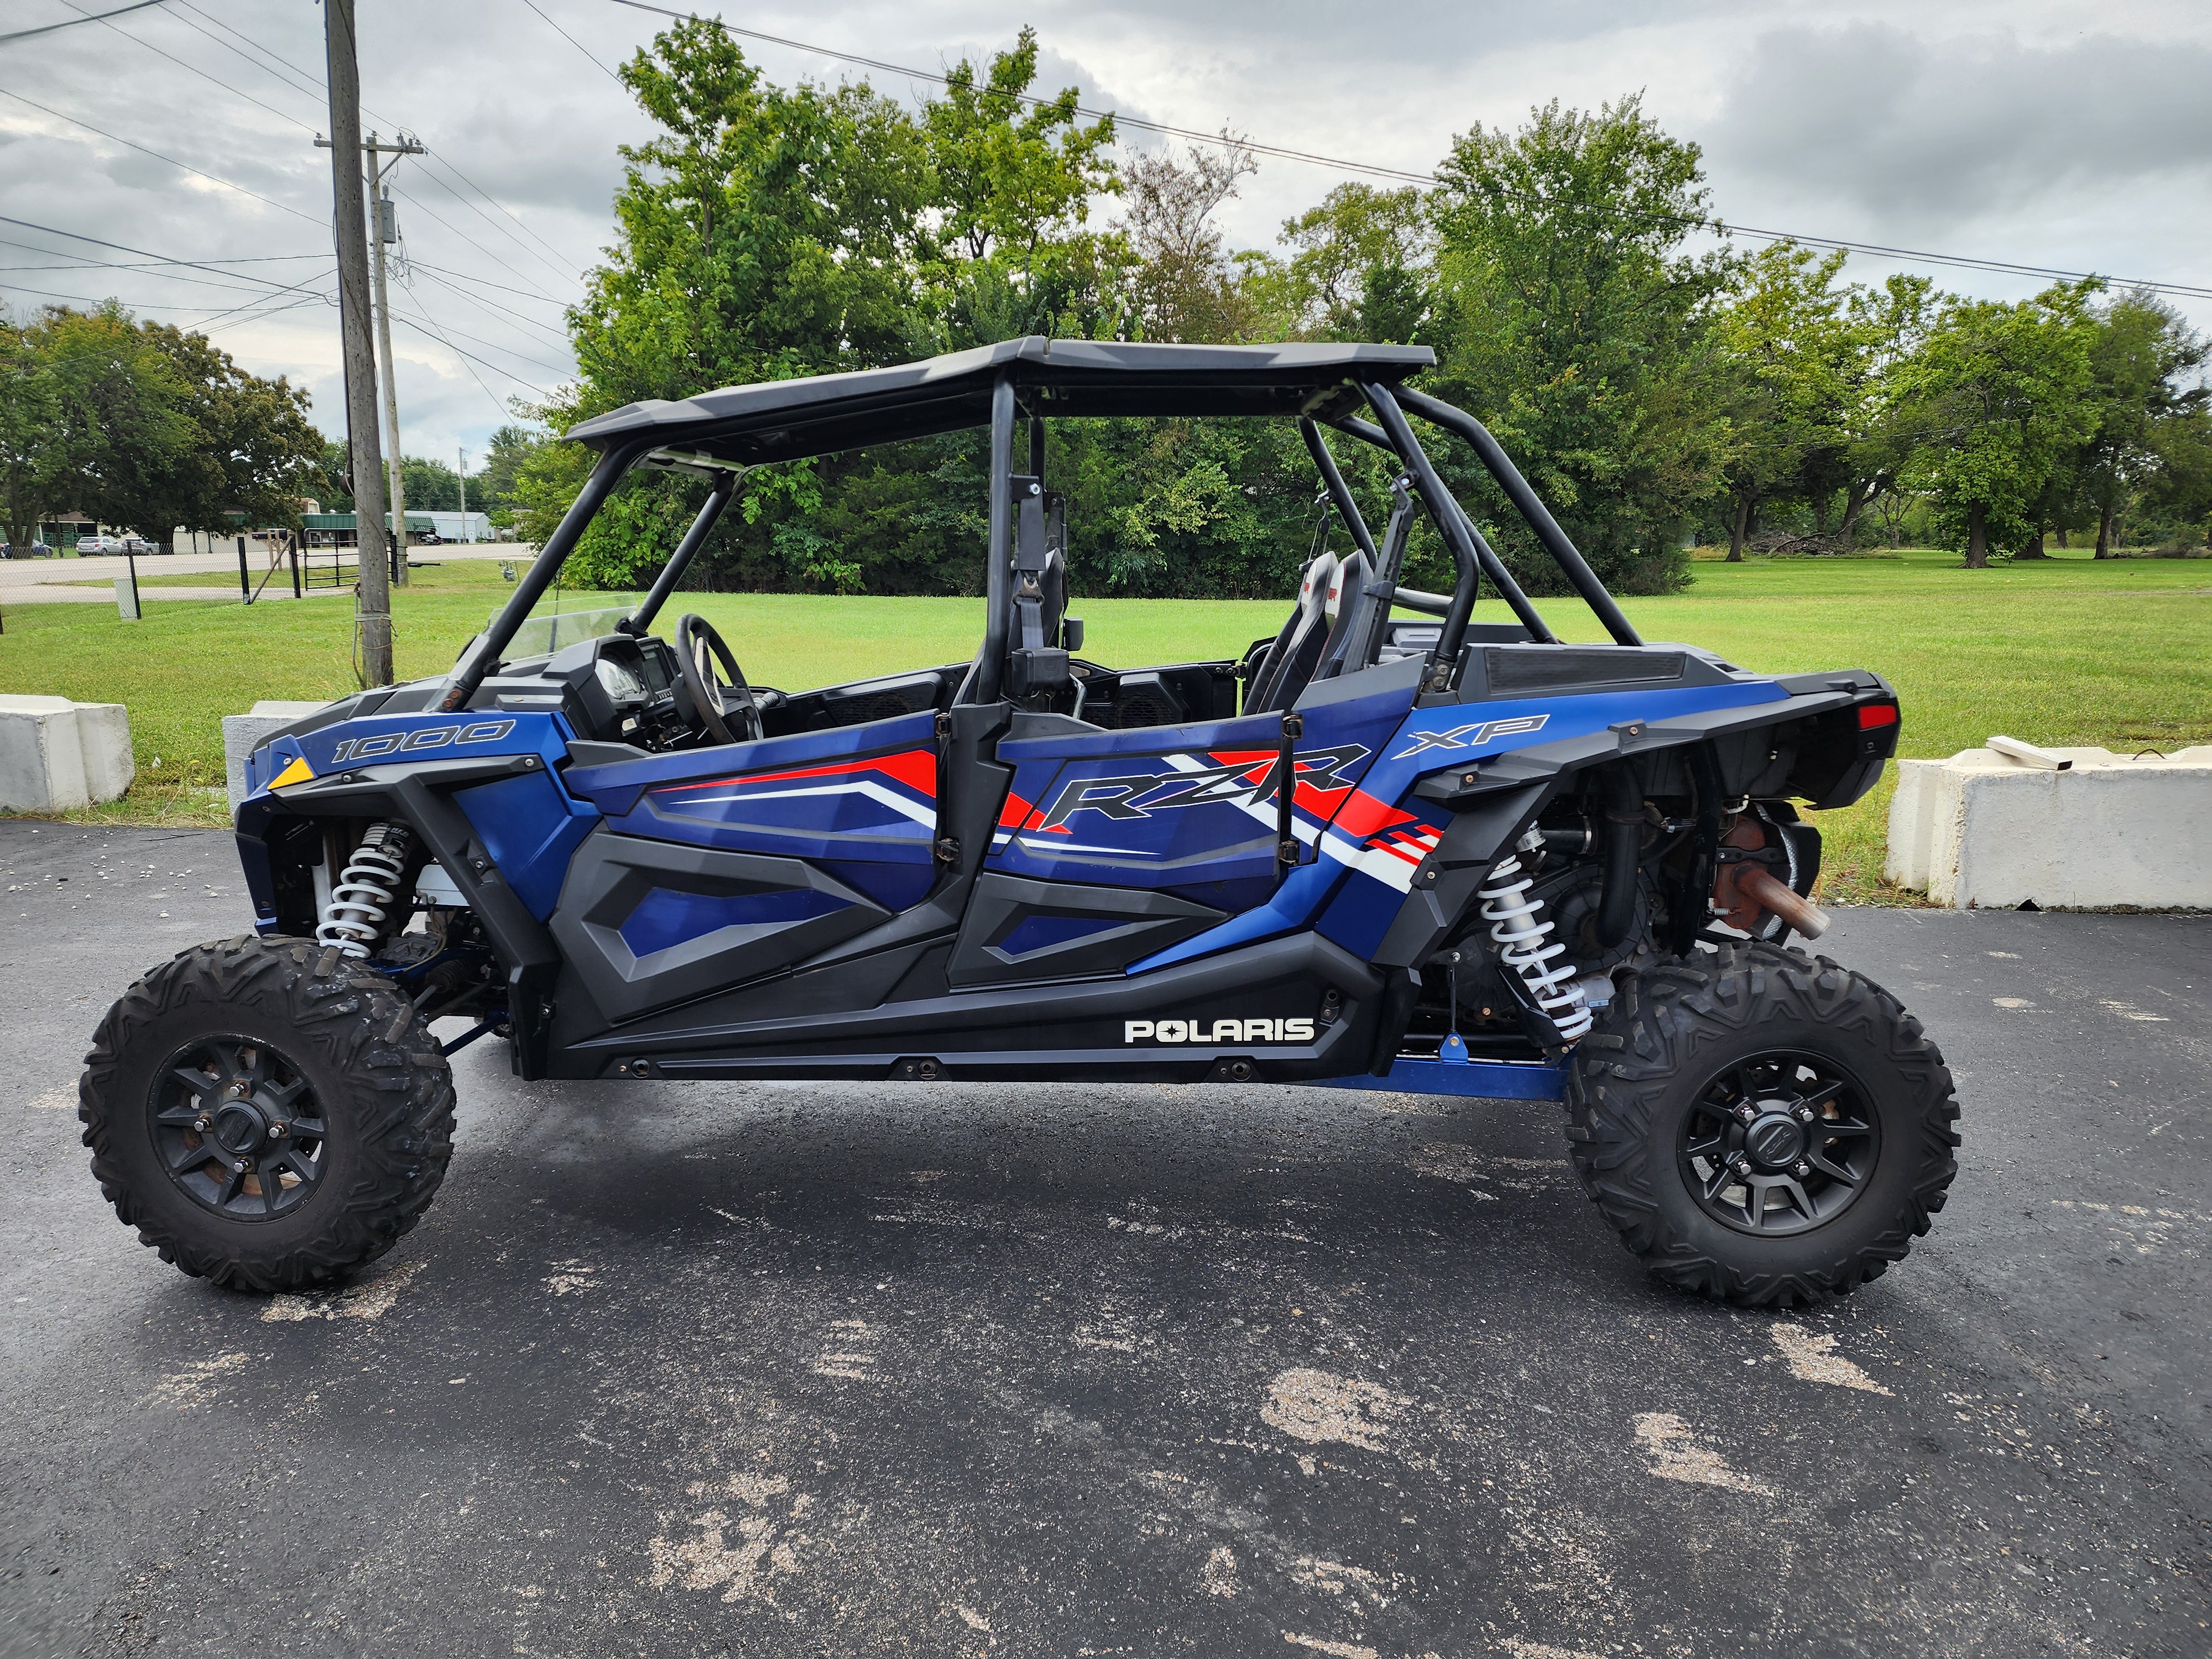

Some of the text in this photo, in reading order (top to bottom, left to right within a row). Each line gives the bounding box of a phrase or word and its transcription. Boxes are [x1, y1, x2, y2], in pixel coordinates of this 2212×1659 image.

[332, 719, 516, 764] 1000
[1390, 714, 1551, 760] XP
[1036, 743, 1371, 832] RZR
[1125, 1018, 1314, 1043] POLARIS
